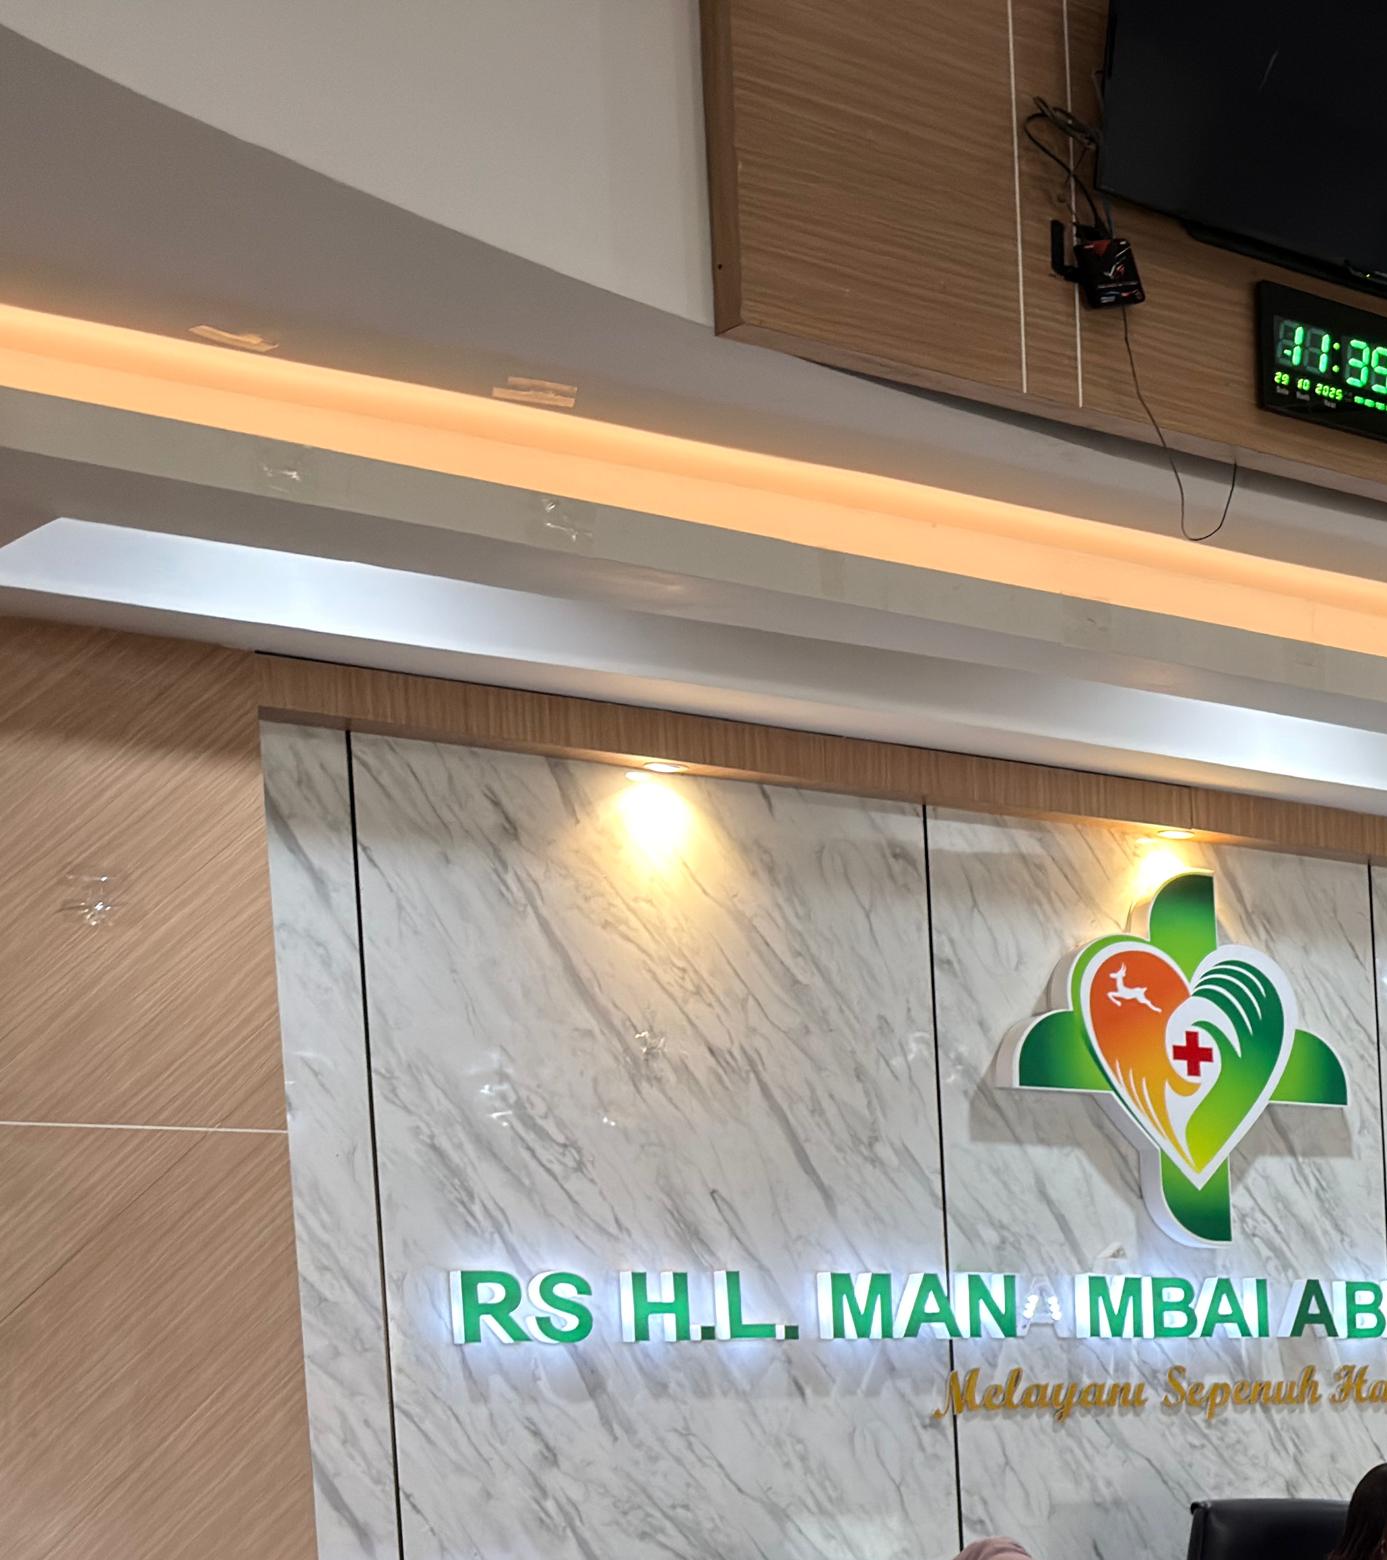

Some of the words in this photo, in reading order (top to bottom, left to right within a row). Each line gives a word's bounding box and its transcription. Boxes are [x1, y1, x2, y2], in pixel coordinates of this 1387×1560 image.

[1274, 371, 1290, 386] 29
[1314, 383, 1343, 401] 2025
[450, 1269, 594, 1344] RS
[620, 1270, 799, 1344] H.L.
[933, 1365, 1147, 1423] Melayani
[1161, 1363, 1321, 1421] Sepenuh
